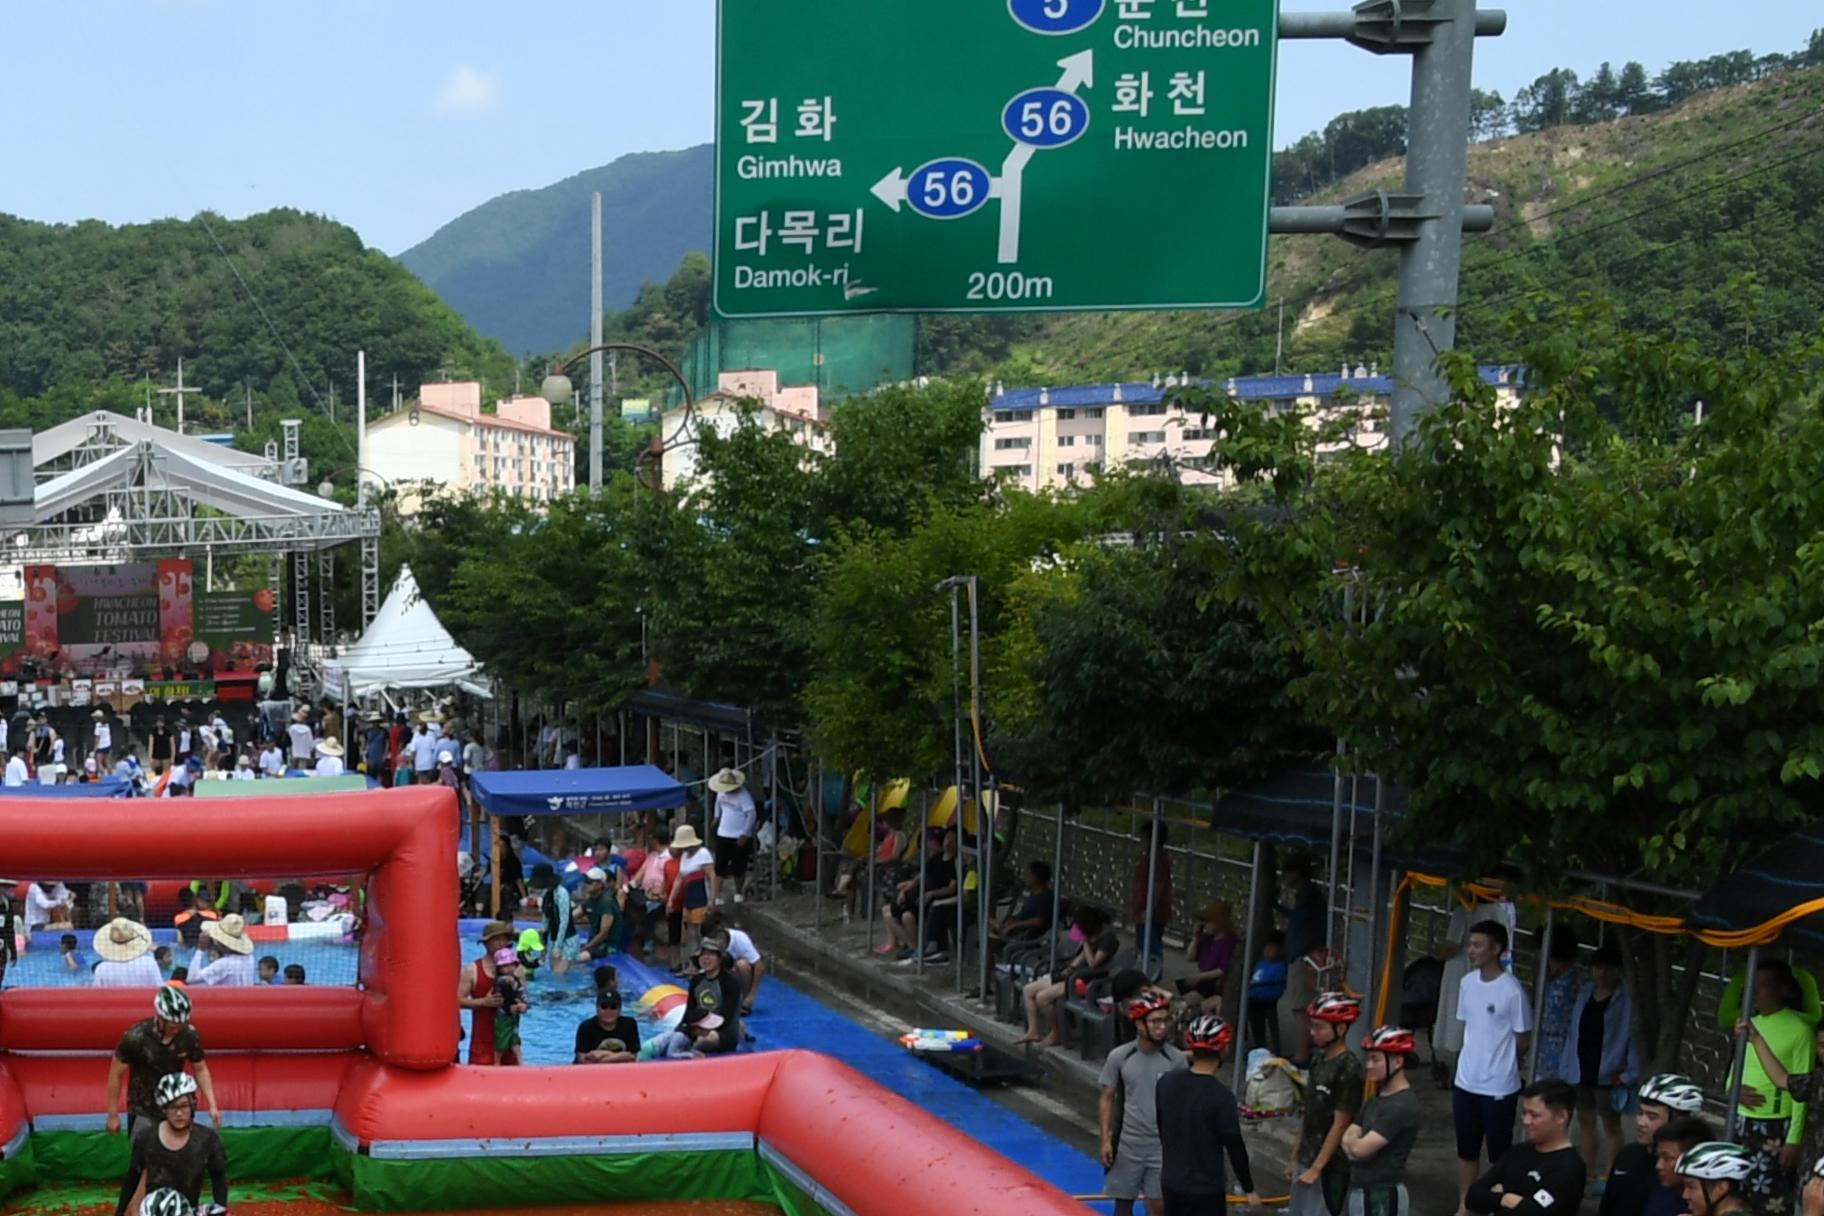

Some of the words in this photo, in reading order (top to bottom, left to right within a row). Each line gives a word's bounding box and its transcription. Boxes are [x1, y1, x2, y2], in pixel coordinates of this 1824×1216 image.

[1113, 25, 1259, 49] Chuncheon
[1020, 100, 1072, 138] 56
[1114, 125, 1249, 150] Hwacheon
[737, 155, 843, 180] Gimhwa
[923, 170, 975, 208] 56
[734, 207, 864, 257] 다목리
[734, 262, 849, 289] Damok-ri
[966, 271, 1054, 300] 200m
[408, 409, 419, 427] 6
[96, 611, 157, 627] TOMATO
